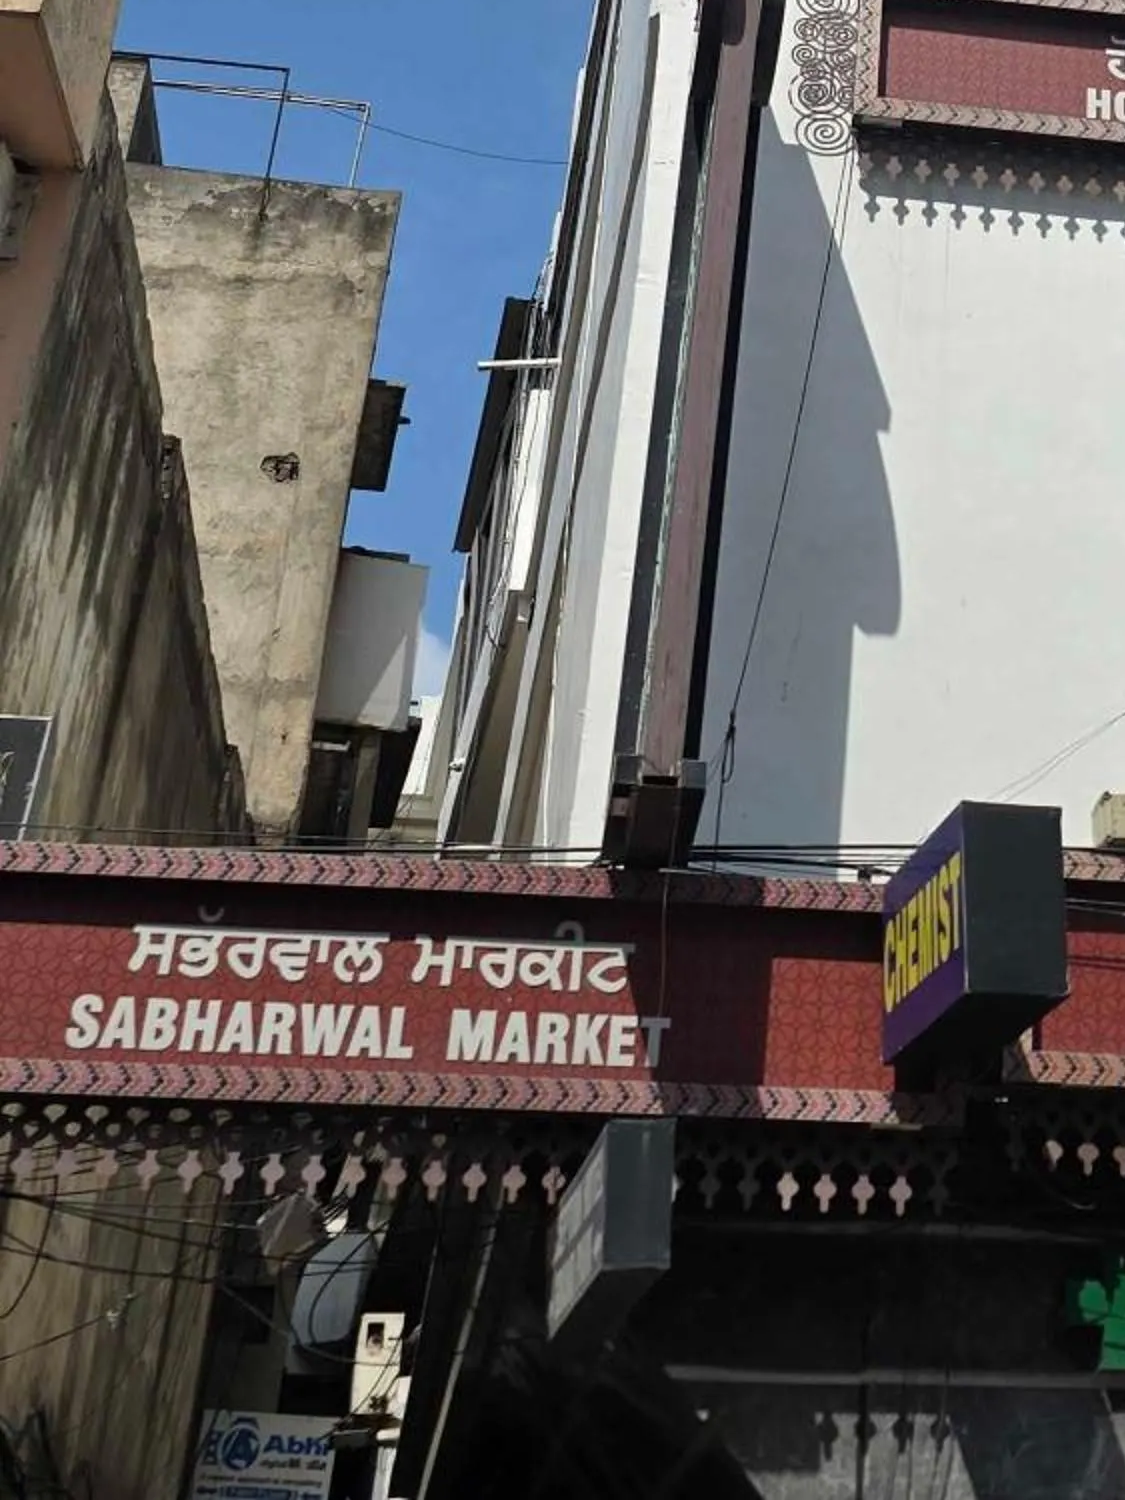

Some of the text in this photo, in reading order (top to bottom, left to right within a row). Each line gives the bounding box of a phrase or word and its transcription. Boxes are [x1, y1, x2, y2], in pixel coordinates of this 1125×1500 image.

[410, 920, 636, 993] ਮਾਰਕੀਟ
[884, 850, 961, 1013] CHEMIST
[64, 993, 672, 1069] SABHARWAL MARKET
